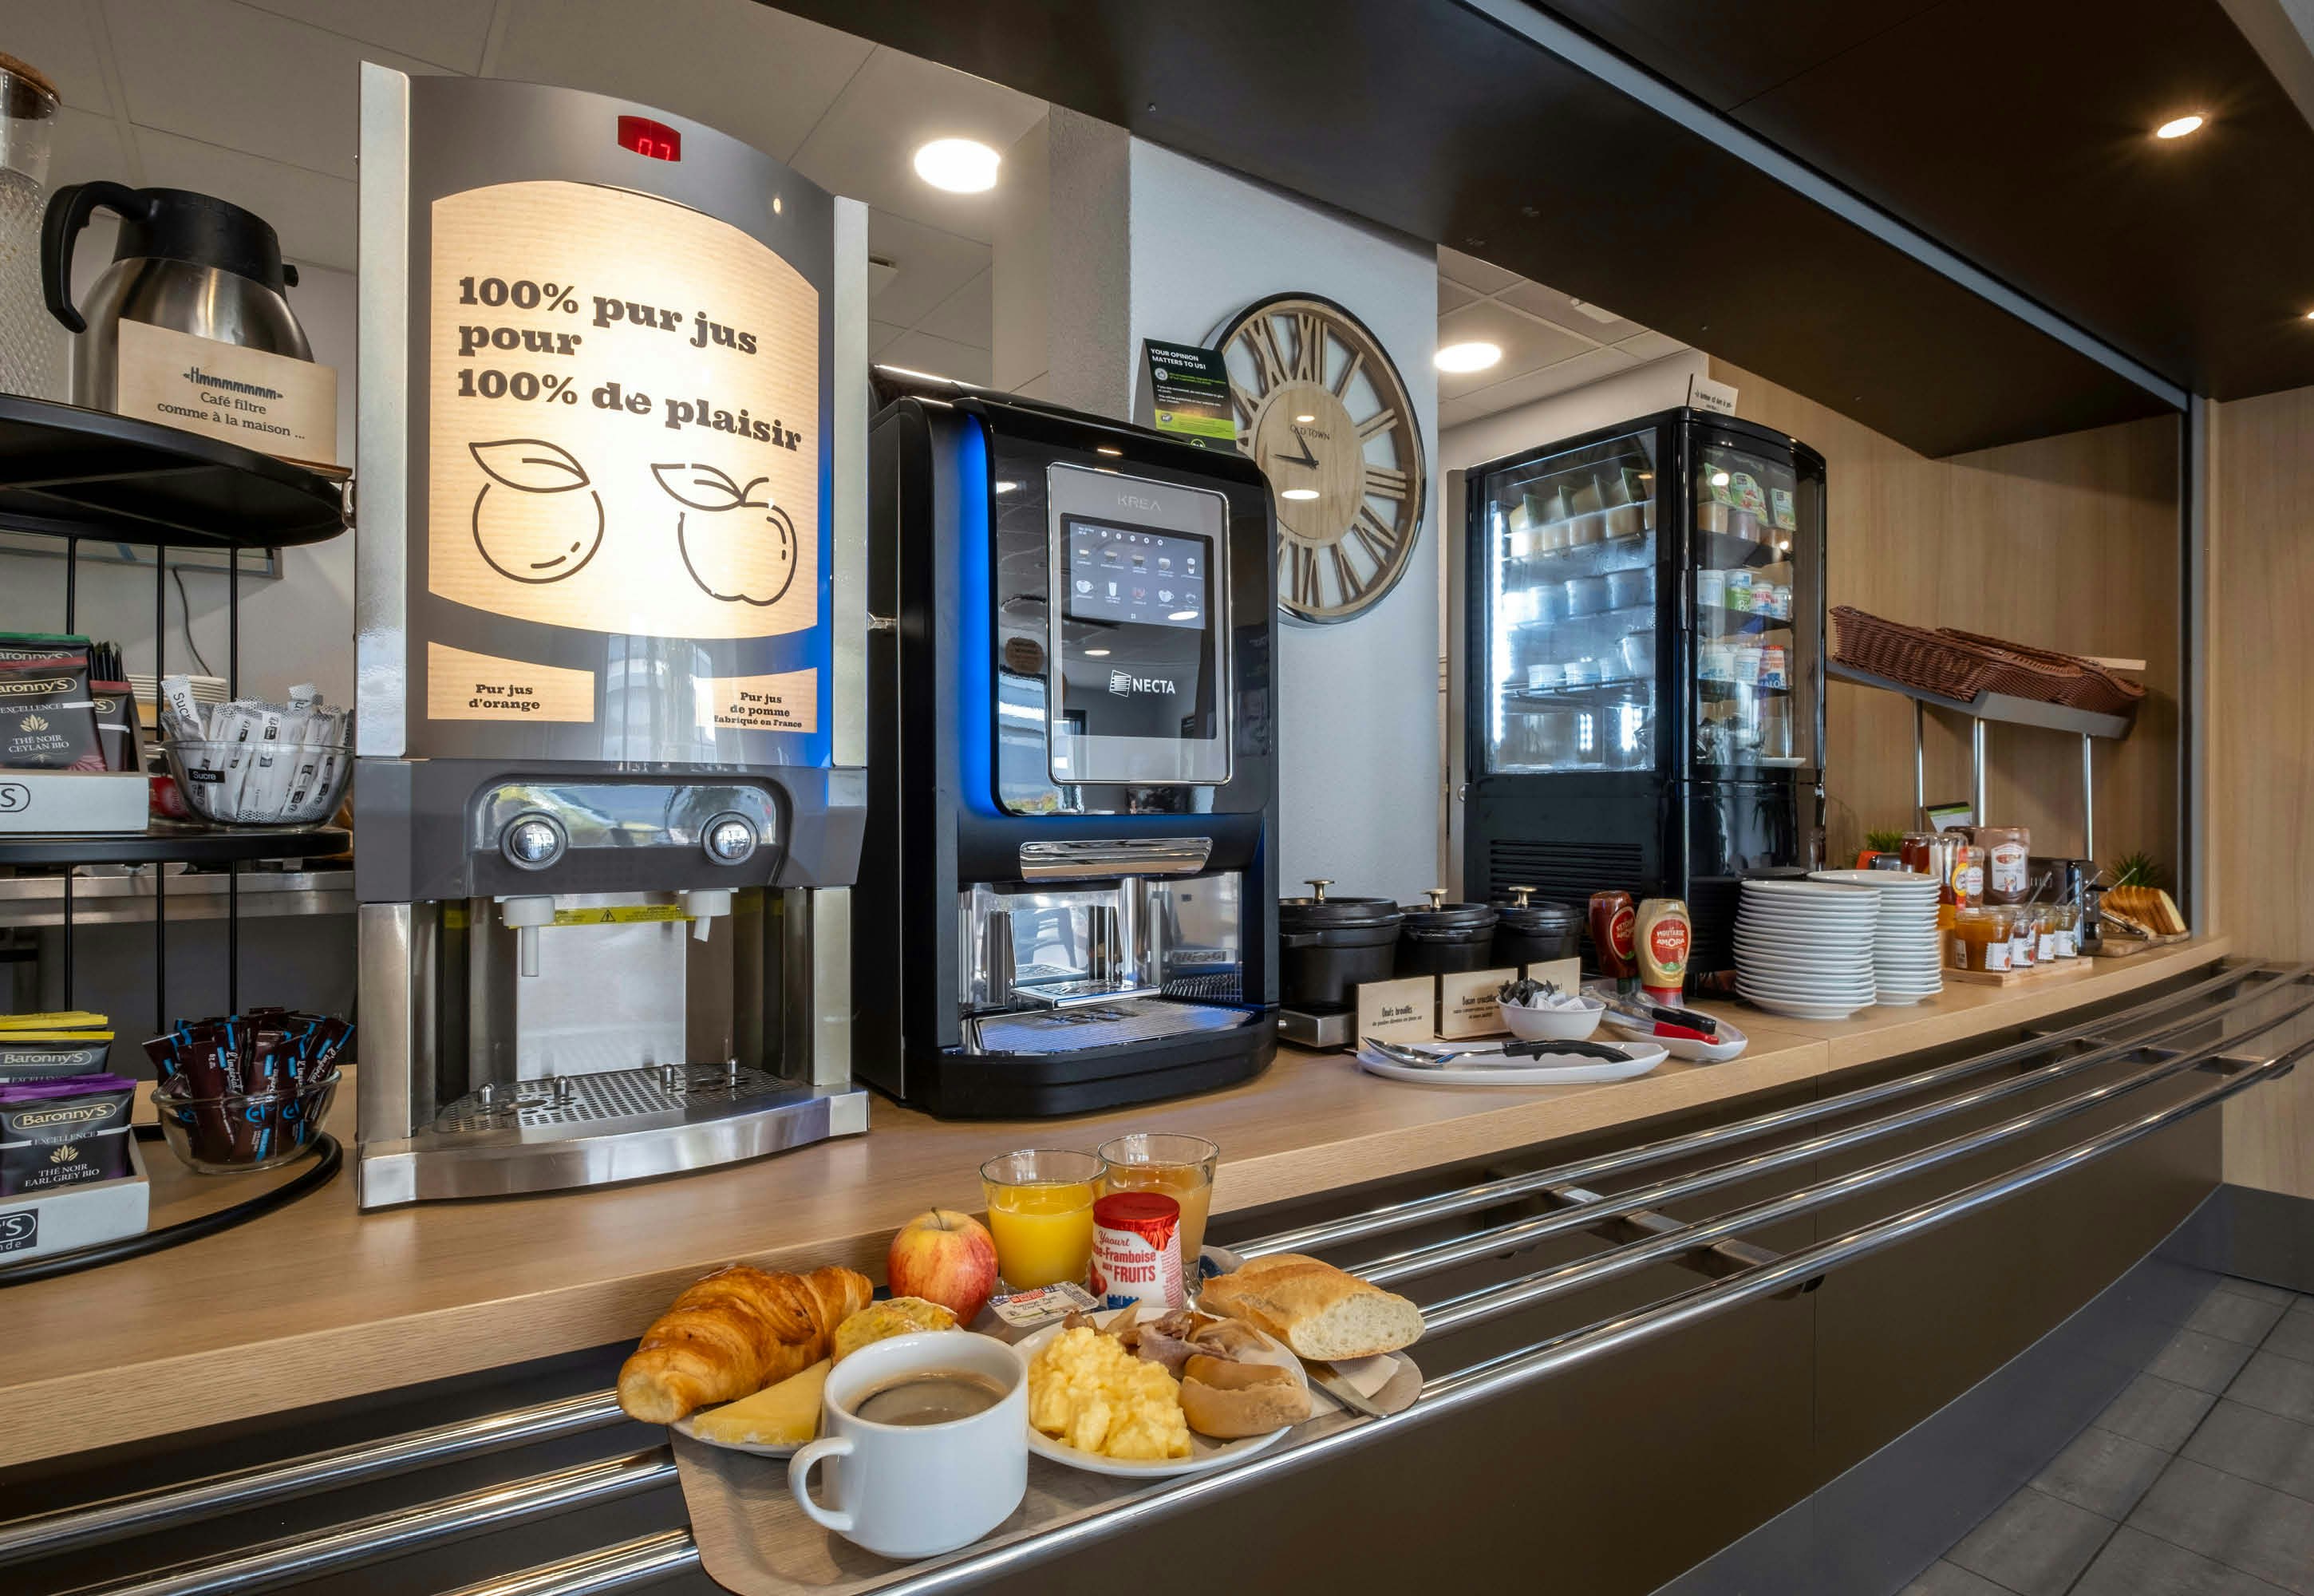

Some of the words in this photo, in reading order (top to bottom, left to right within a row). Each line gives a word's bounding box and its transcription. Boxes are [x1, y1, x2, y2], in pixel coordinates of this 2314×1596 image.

[459, 276, 579, 314] 100%
[593, 295, 683, 333] pur
[689, 311, 757, 355] jus
[458, 325, 582, 357] pour
[1151, 348, 1170, 357] YOUR
[1171, 352, 1199, 361] OPINION
[1152, 356, 1183, 366] MATTERS
[200, 392, 231, 408] Café
[235, 398, 267, 414] filtre
[458, 369, 578, 405] 100%
[591, 381, 652, 415] de
[665, 397, 802, 452] plaisir
[157, 402, 208, 421] comme
[212, 411, 221, 423] à
[226, 413, 238, 426] la
[242, 419, 290, 437] maison
[1308, 427, 1330, 440] TOWN
[0, 679, 69, 693] aronny'S
[476, 684, 505, 693] Pur
[507, 684, 533, 697] jus
[1133, 678, 1175, 694] NECTA
[173, 692, 192, 719] Sucr
[468, 697, 541, 713] d'orange
[740, 692, 763, 702] Pur
[764, 693, 782, 705] jus
[730, 705, 745, 714] de
[748, 707, 790, 717] pomme
[773, 719, 802, 728] France
[36, 734, 63, 743] NOIR
[8, 743, 50, 753] CEYLAN
[193, 770, 216, 780] Sucre
[1657, 938, 1685, 947] AMORA
[34, 1130, 99, 1146] EXCELLENCE
[61, 1163, 88, 1175] NOIR
[25, 1175, 52, 1187] EARL
[53, 1172, 80, 1183] GREY
[82, 1168, 100, 1177] BIO
[1098, 1230, 1131, 1246] Yaourt
[1114, 1265, 1156, 1283] FRUITS
